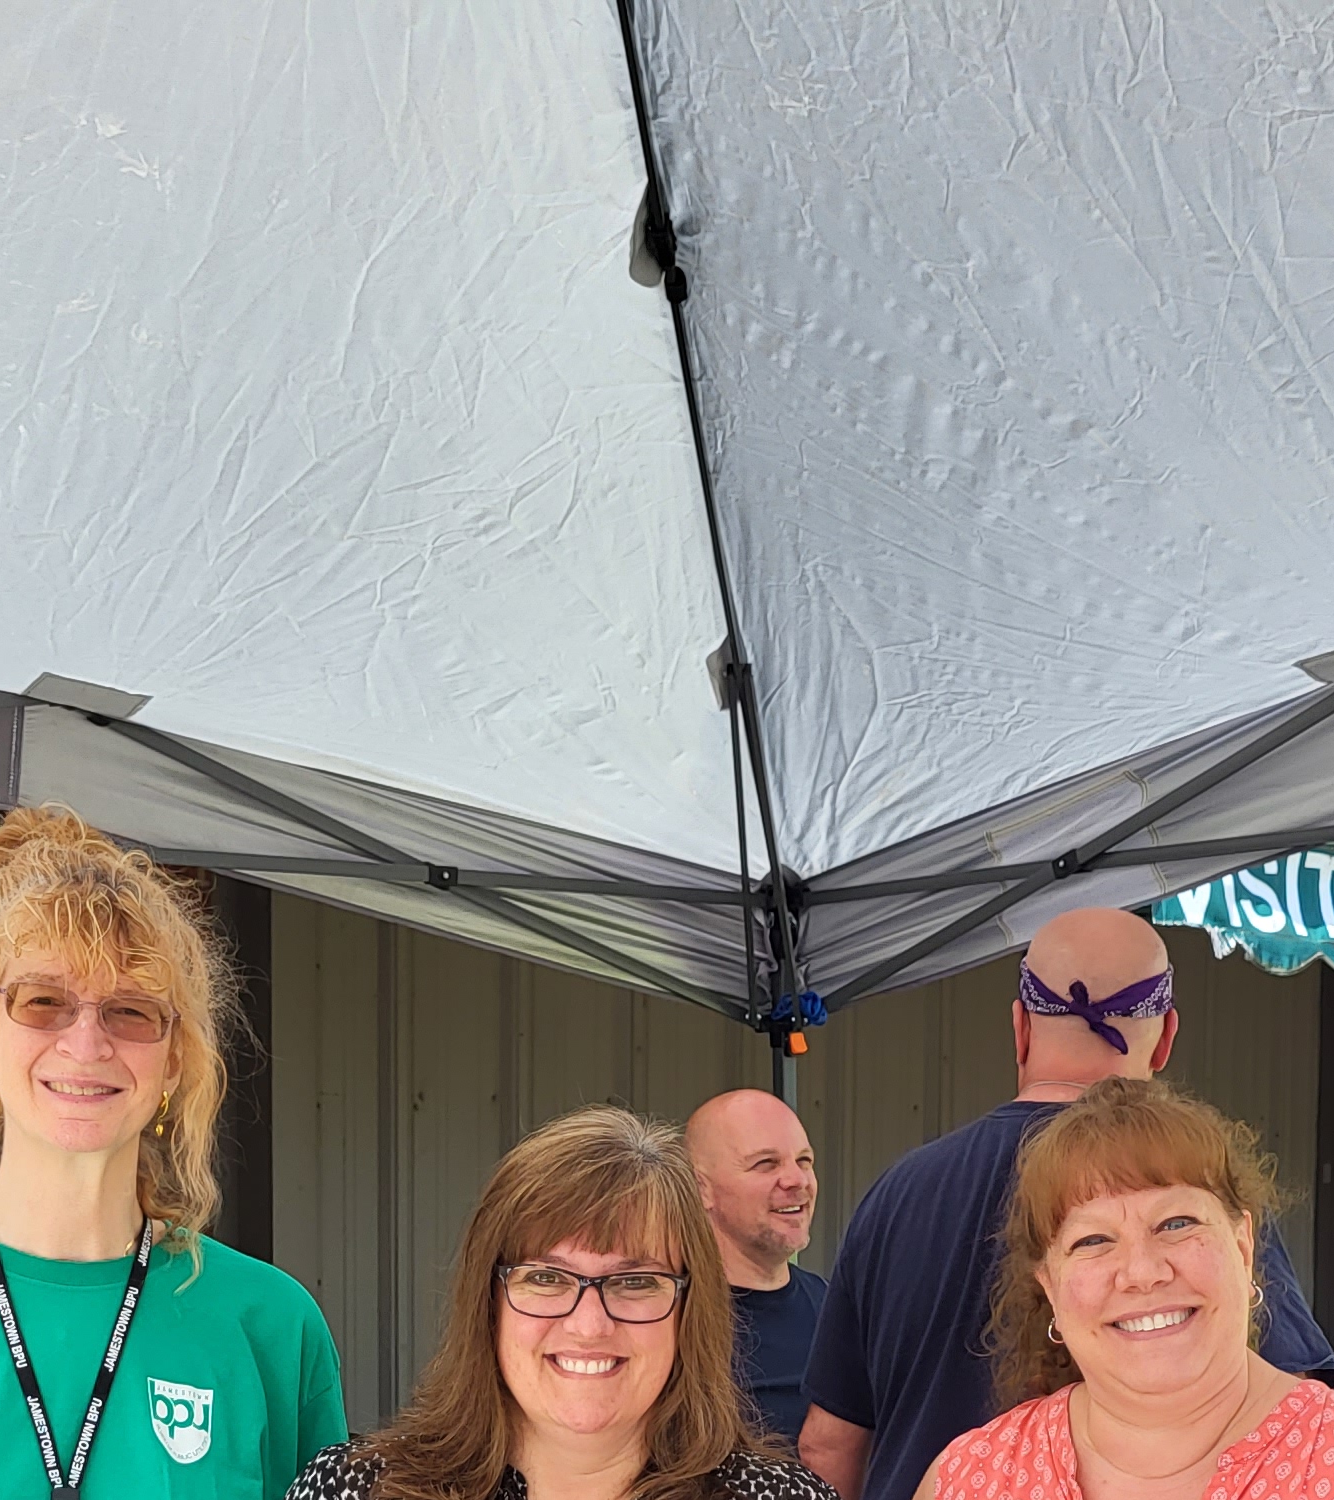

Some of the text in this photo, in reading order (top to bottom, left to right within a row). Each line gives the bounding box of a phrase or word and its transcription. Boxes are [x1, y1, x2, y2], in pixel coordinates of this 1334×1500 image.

[11, 1344, 28, 1369] BPU
[104, 1286, 139, 1372] JAMESTOWN BPU
[27, 1395, 57, 1468] JAMESTOWN
[68, 1397, 103, 1488] AMESTOWN BPU
[149, 1380, 209, 1439] bpu
